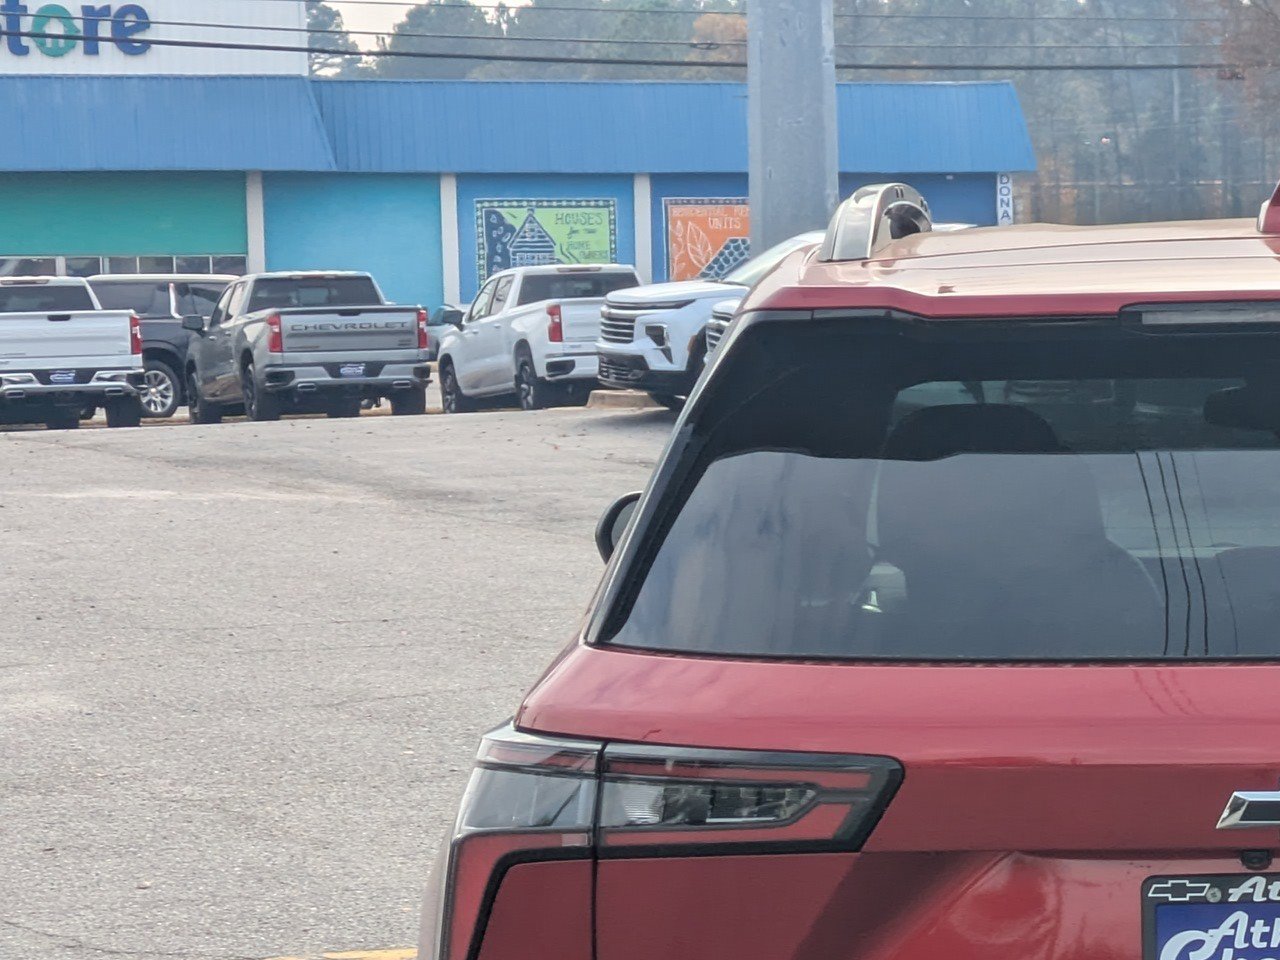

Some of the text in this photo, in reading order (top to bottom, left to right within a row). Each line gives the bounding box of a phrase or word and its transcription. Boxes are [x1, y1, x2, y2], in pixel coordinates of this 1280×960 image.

[0, 0, 152, 57] tore
[554, 211, 603, 225] HOUSES
[290, 321, 408, 332] CHEVROLET
